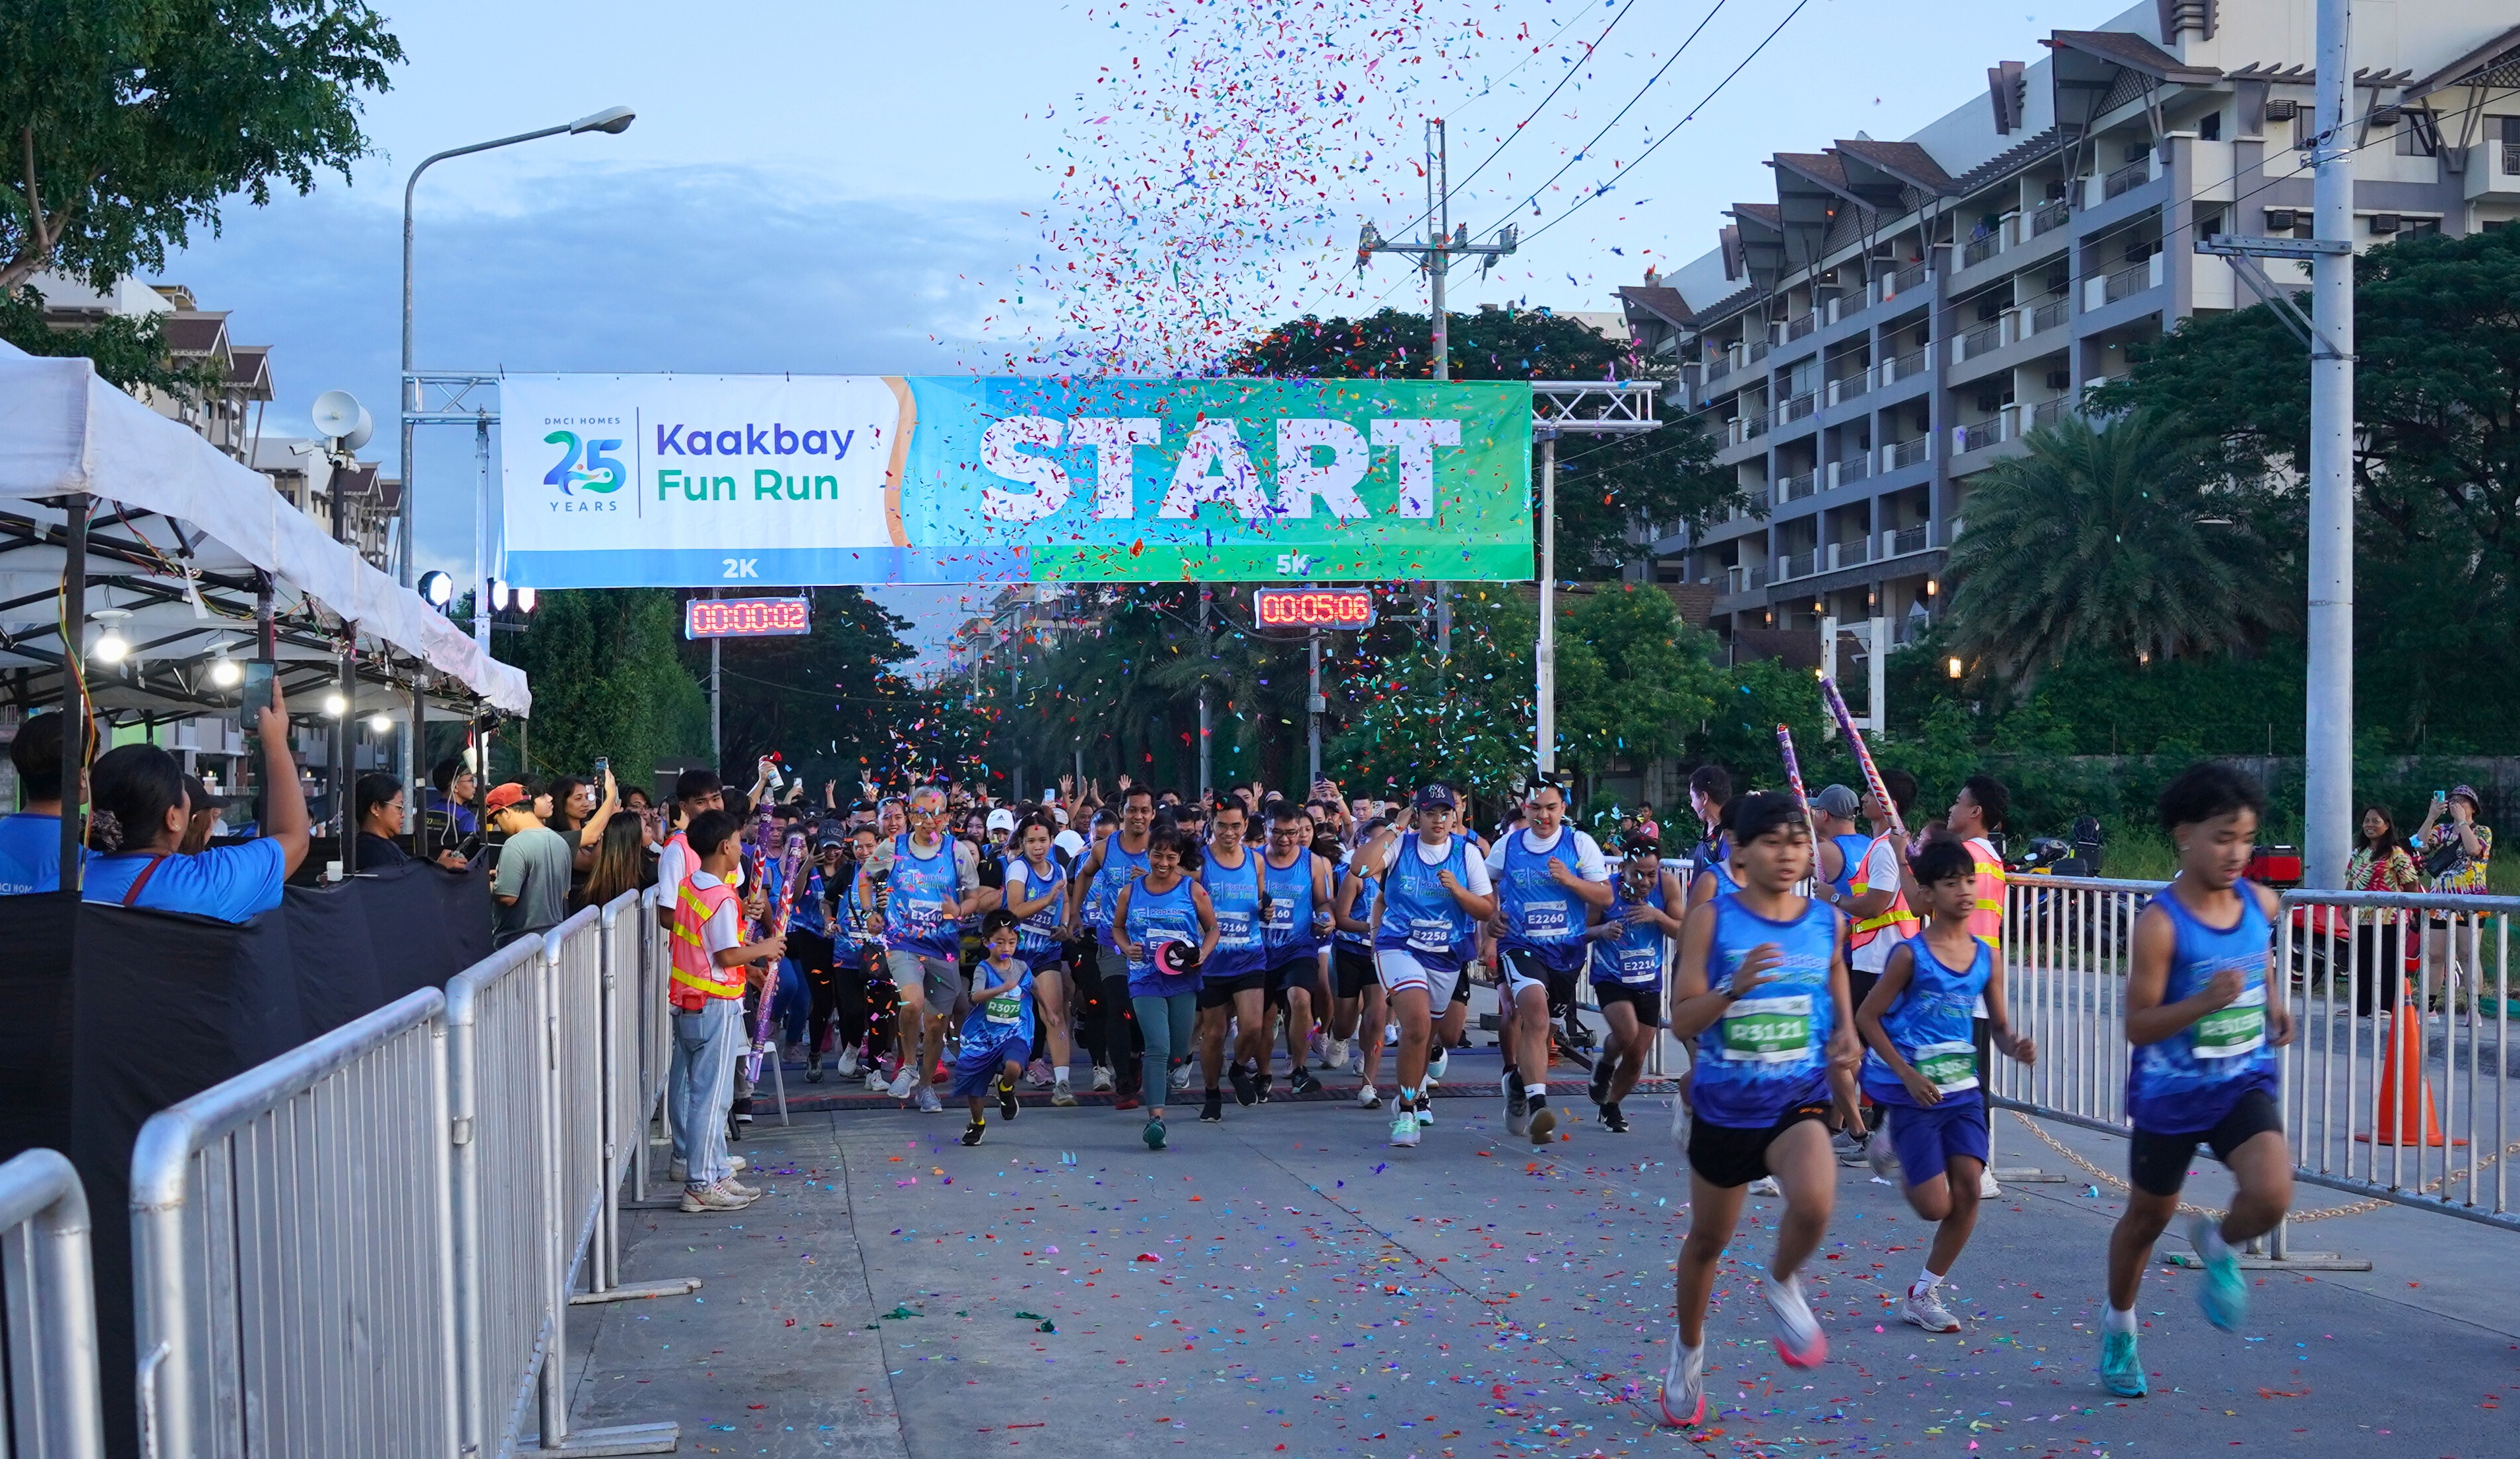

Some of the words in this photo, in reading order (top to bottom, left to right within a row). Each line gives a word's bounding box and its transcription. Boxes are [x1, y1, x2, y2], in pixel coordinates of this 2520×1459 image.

[657, 423, 855, 461] Kaakbay
[543, 430, 626, 496] 25
[979, 414, 1462, 521] START
[658, 469, 736, 502] Fun
[754, 469, 839, 501] Run
[550, 501, 617, 512] YEARS
[722, 558, 759, 579] 2K
[1276, 554, 1310, 573] 5K
[694, 603, 805, 633] 00:00:02
[1262, 594, 1369, 624] 00:05:06
[1272, 909, 1291, 919] 160
[1528, 913, 1565, 924] E2260
[1218, 922, 1248, 932] E2166
[1413, 929, 1448, 941] E2258
[1624, 959, 1656, 971] E2214
[1730, 1020, 1805, 1042] R3121
